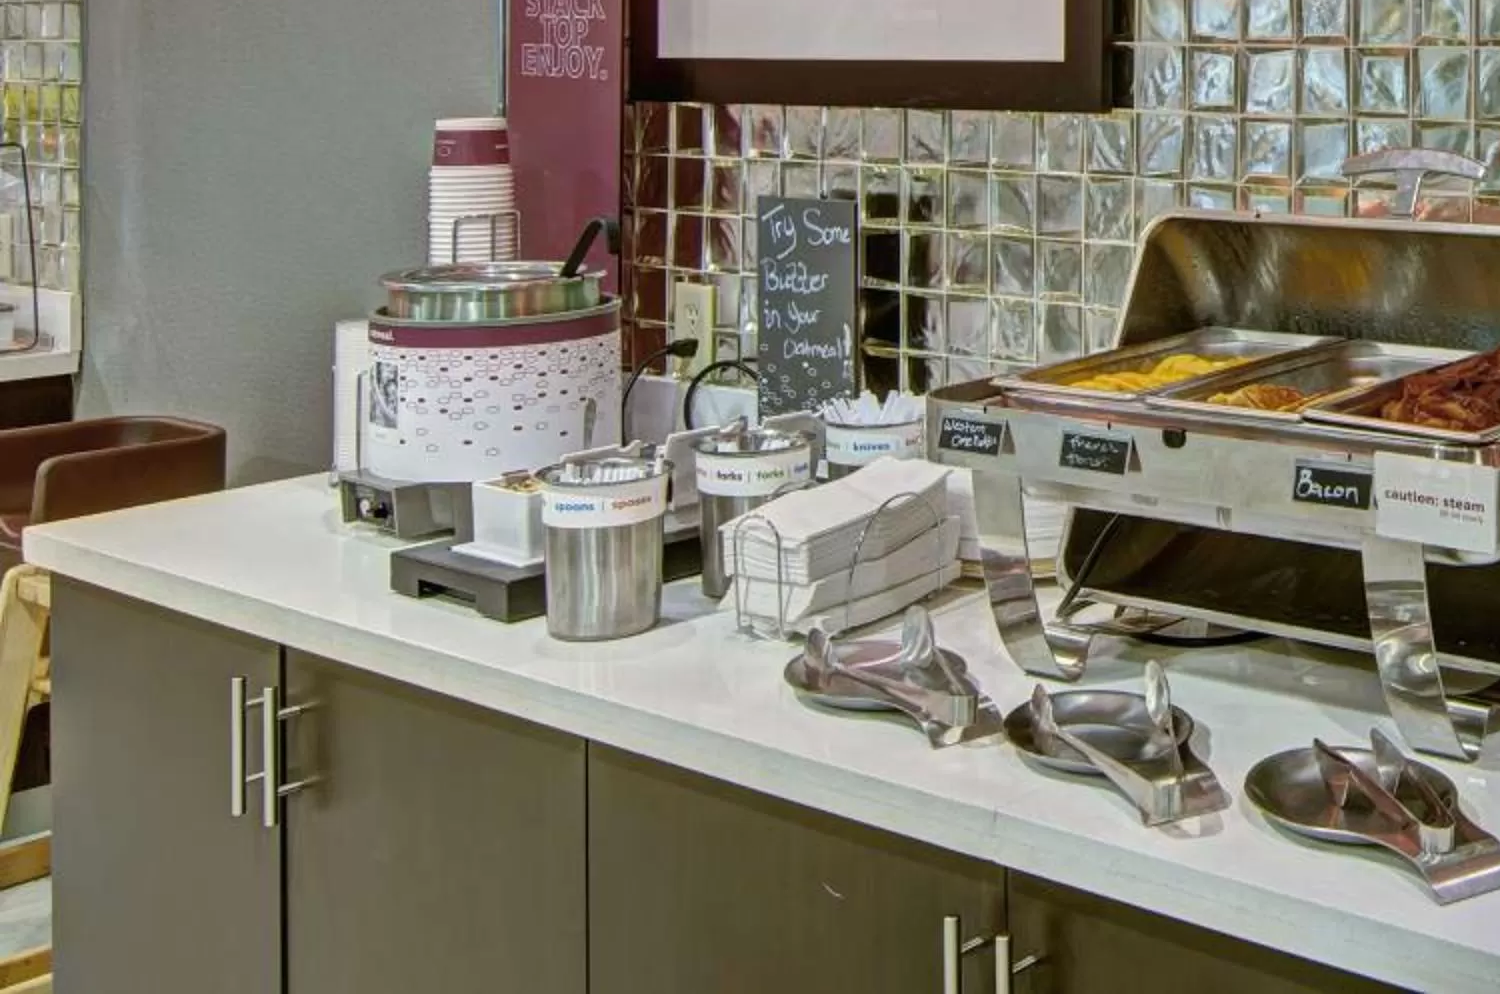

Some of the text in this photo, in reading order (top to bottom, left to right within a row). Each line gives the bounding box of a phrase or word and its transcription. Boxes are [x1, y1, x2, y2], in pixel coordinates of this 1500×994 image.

[540, 17, 588, 49] TOP
[520, 43, 609, 80] ENJOY.
[761, 204, 850, 259] Try Some
[763, 299, 781, 329] in
[852, 441, 892, 452] knives
[1295, 469, 1359, 505] Bacon
[1384, 488, 1486, 513] caution: steam
[555, 501, 596, 513] spoons
